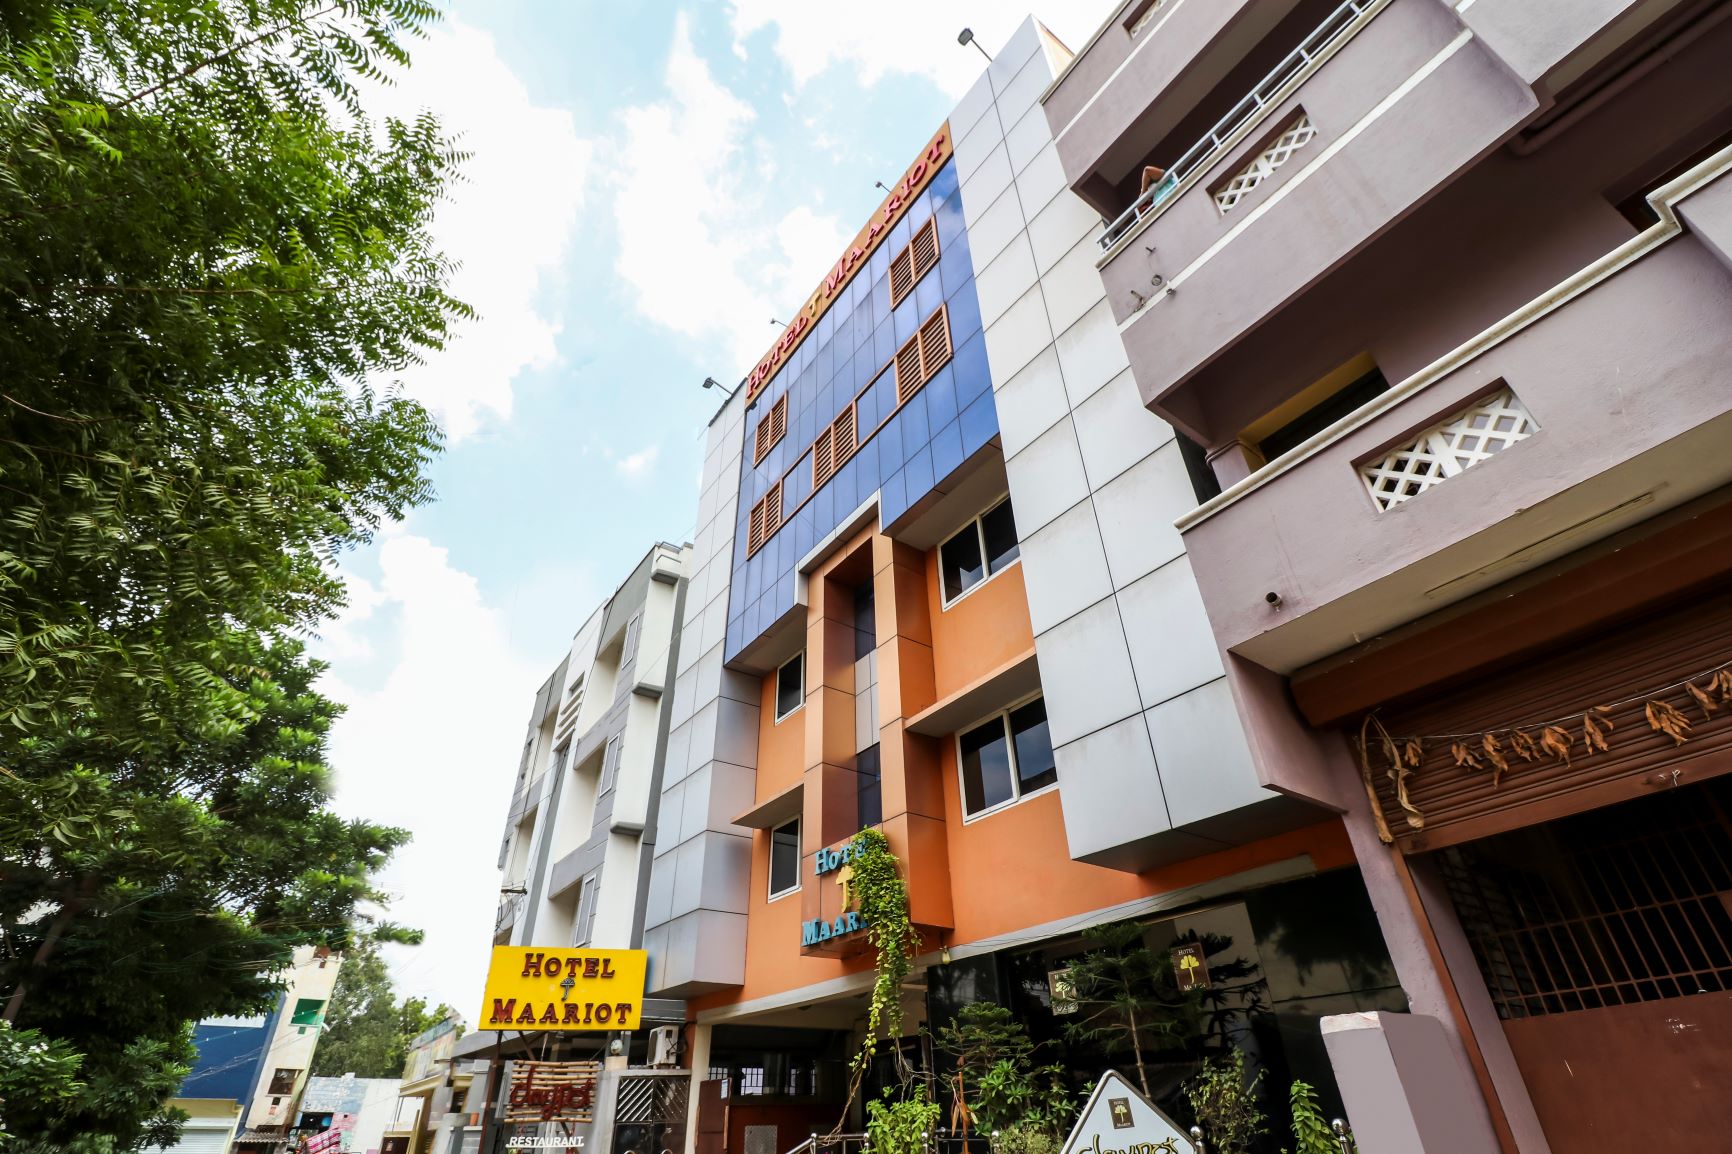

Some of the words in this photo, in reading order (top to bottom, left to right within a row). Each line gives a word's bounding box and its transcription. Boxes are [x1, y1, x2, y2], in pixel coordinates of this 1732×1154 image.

[747, 316, 808, 399] HOTEL
[824, 134, 946, 298] MAARIOT
[814, 838, 868, 876] HOTE
[801, 911, 869, 947] MAAR
[521, 953, 616, 978] HOTEL
[489, 998, 633, 1024] MAARIOT
[508, 1136, 585, 1147] RESTAURANT
